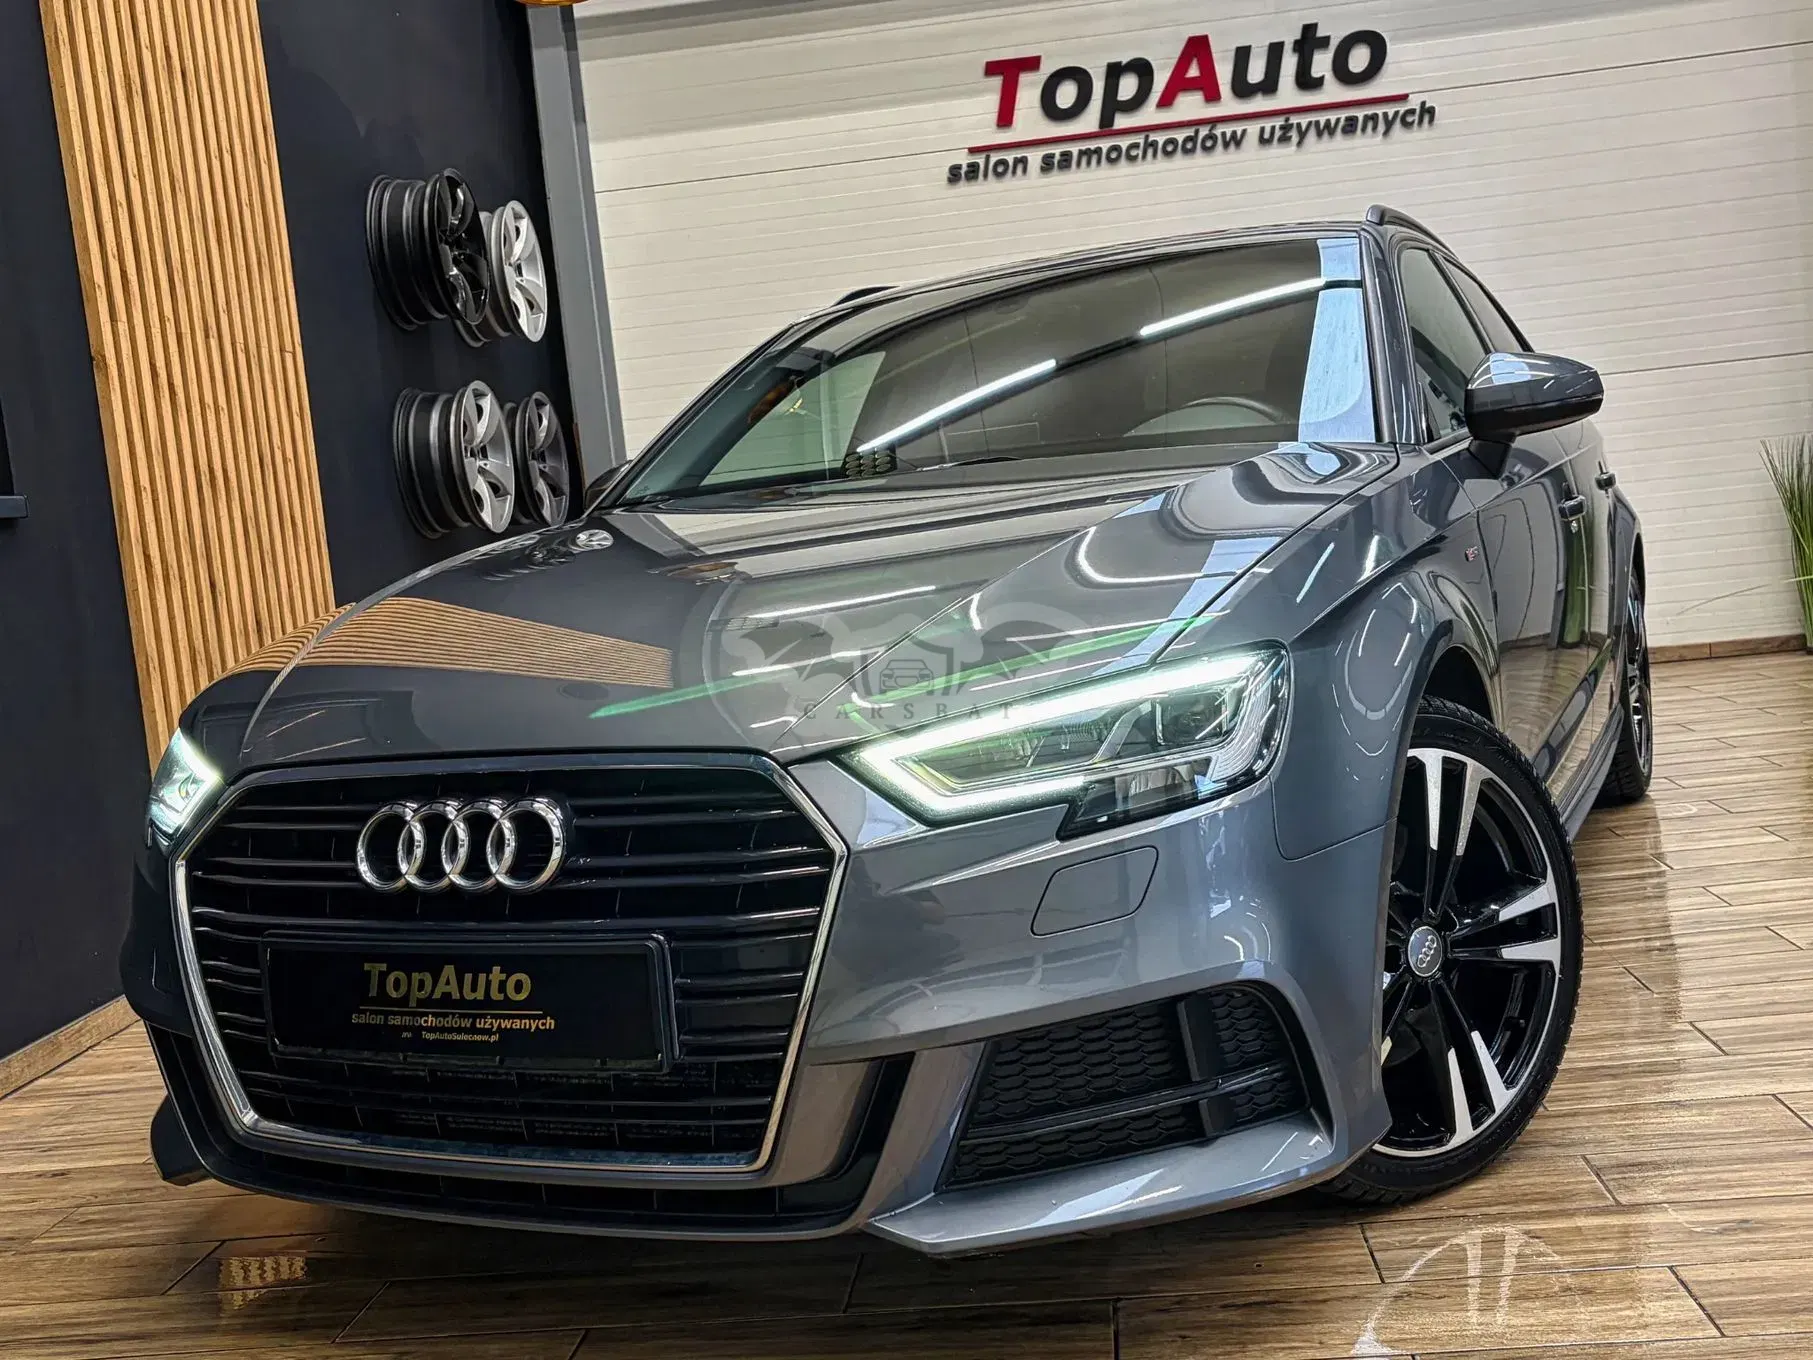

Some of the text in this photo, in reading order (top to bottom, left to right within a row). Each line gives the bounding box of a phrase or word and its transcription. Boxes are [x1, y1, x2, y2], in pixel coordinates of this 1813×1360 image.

[985, 22, 1388, 129] TopAuto
[947, 101, 1436, 184] salon samochodów używanych
[363, 962, 532, 1006] TopAuto
[352, 1012, 555, 1033] salon samochodów używanych
